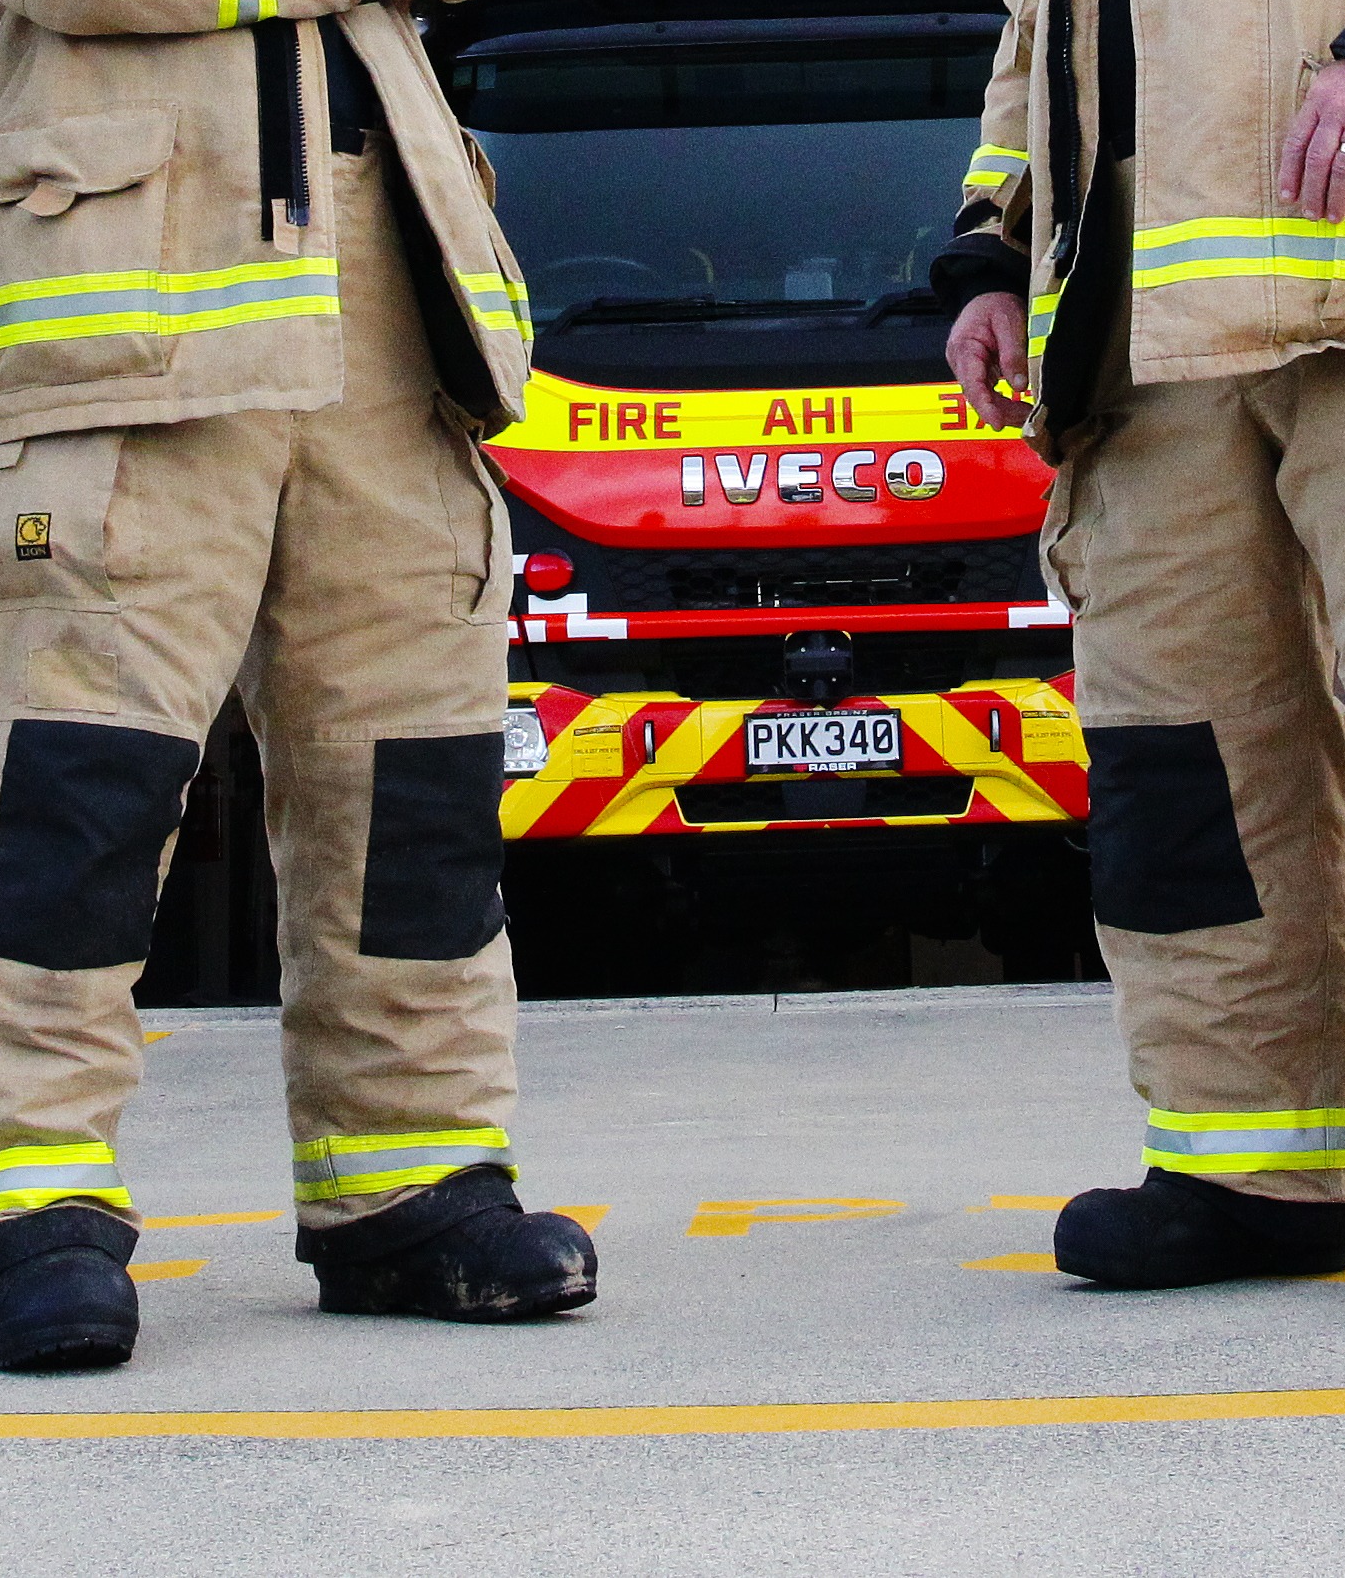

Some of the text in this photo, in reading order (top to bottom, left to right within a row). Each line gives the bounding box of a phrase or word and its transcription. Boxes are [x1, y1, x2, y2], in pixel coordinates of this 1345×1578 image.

[569, 396, 852, 442] FIRE AHI
[681, 448, 945, 507] IVECO
[753, 719, 894, 759] PKK340
